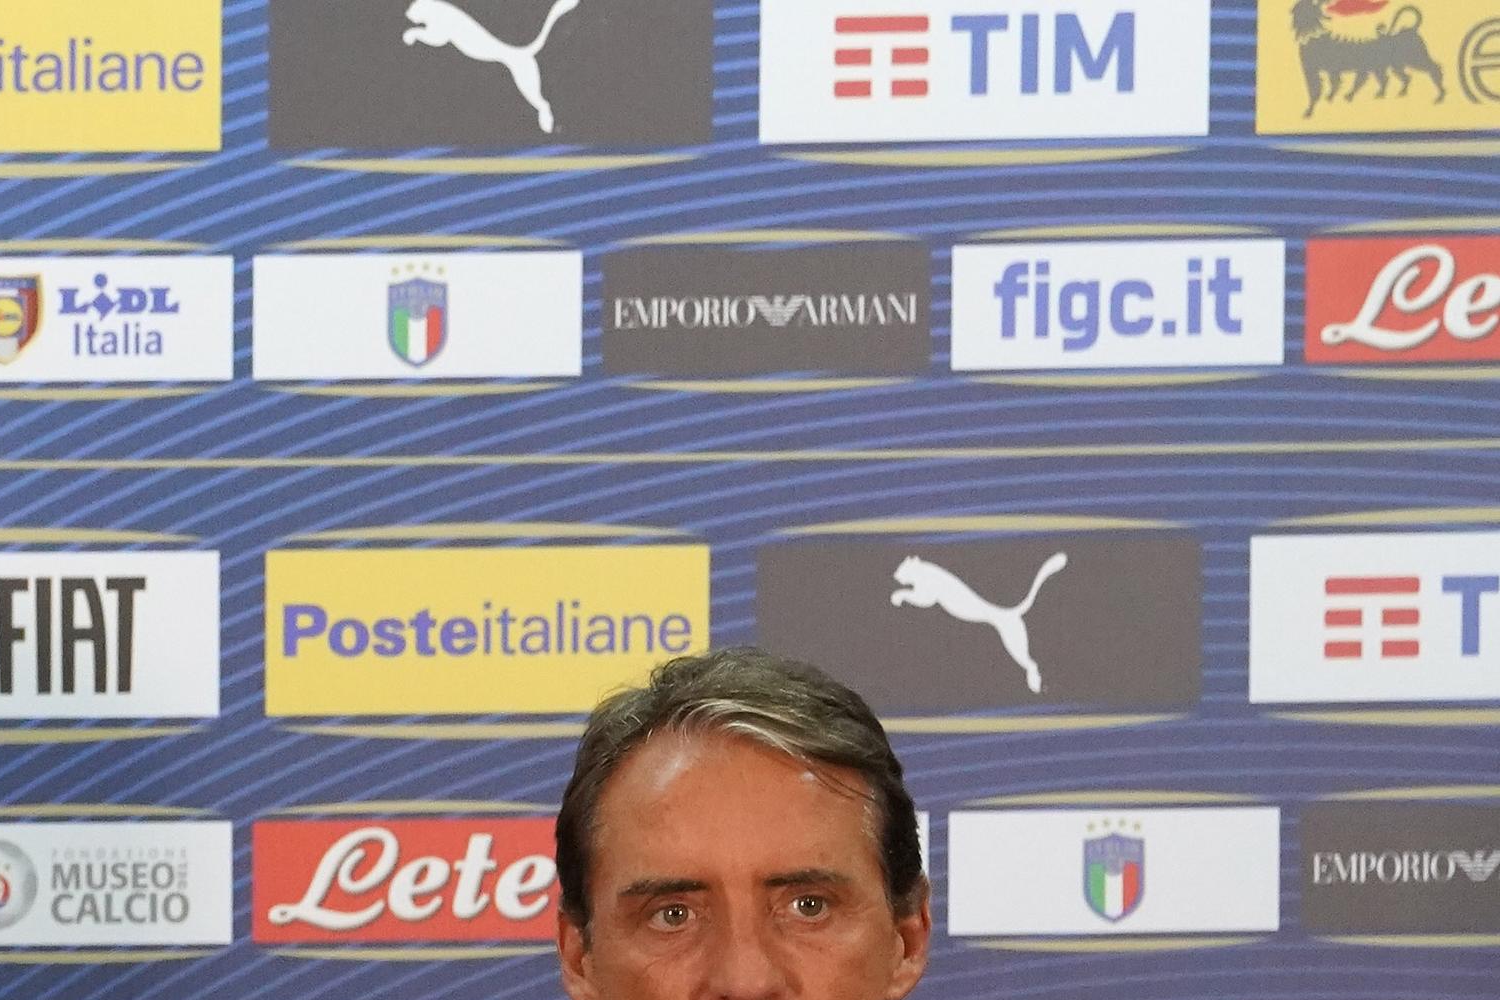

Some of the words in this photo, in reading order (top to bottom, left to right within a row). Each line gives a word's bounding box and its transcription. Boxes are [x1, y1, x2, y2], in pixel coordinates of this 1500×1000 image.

[951, 12, 1135, 96] TIM
[614, 296, 756, 329] EMPORIO
[800, 293, 918, 326] ARMANI
[994, 257, 1242, 352] figc.it
[1321, 244, 1500, 349] Le
[73, 322, 163, 356] Italia
[52, 863, 175, 890] MUSEO
[268, 827, 557, 929] Lete
[1313, 851, 1456, 884] EMPORIO
[51, 892, 189, 924] CALCIO
